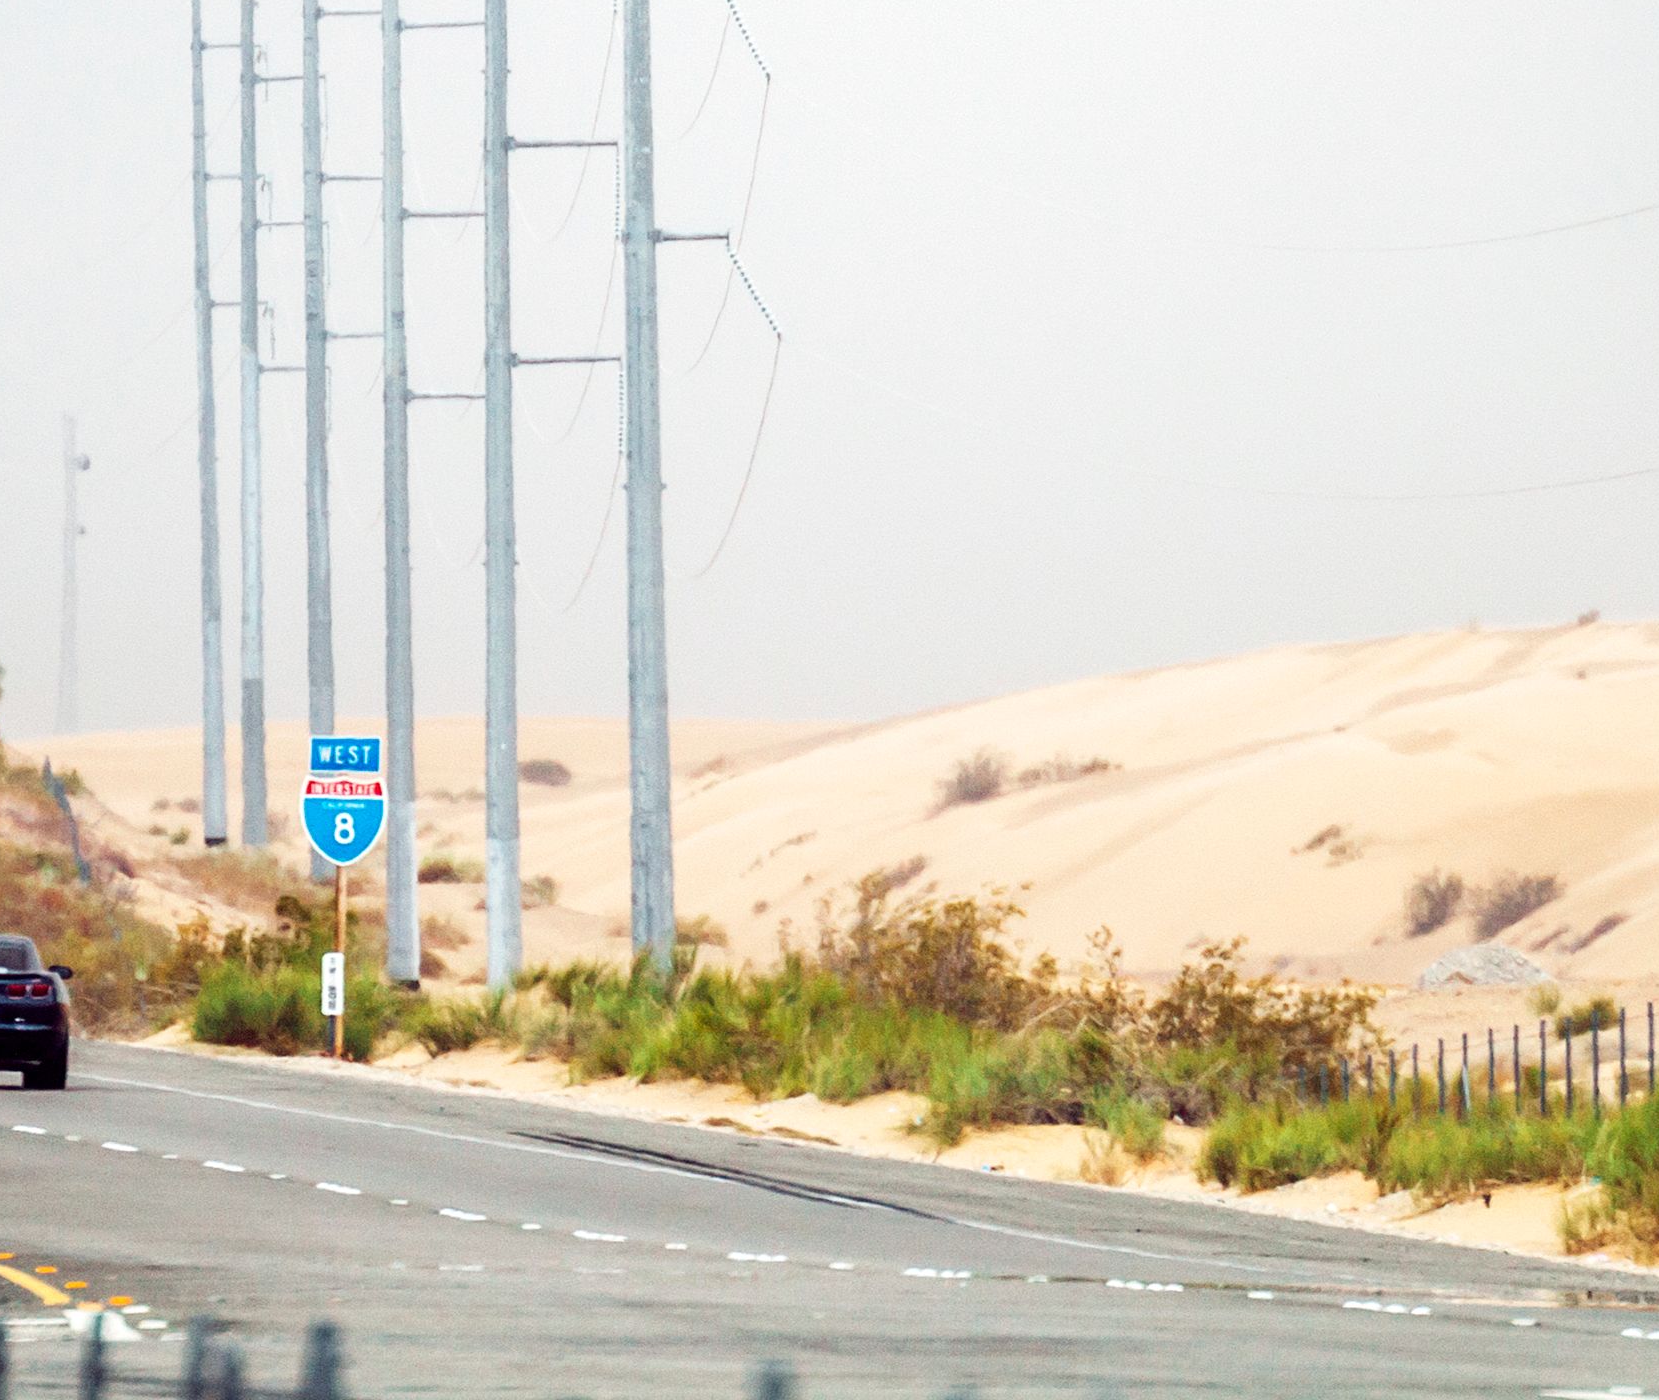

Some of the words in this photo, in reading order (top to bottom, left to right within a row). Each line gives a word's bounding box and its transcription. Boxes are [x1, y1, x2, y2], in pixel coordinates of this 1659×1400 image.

[318, 746, 371, 764] WEST
[311, 782, 376, 795] INTERSTATE
[334, 812, 355, 844] 8
